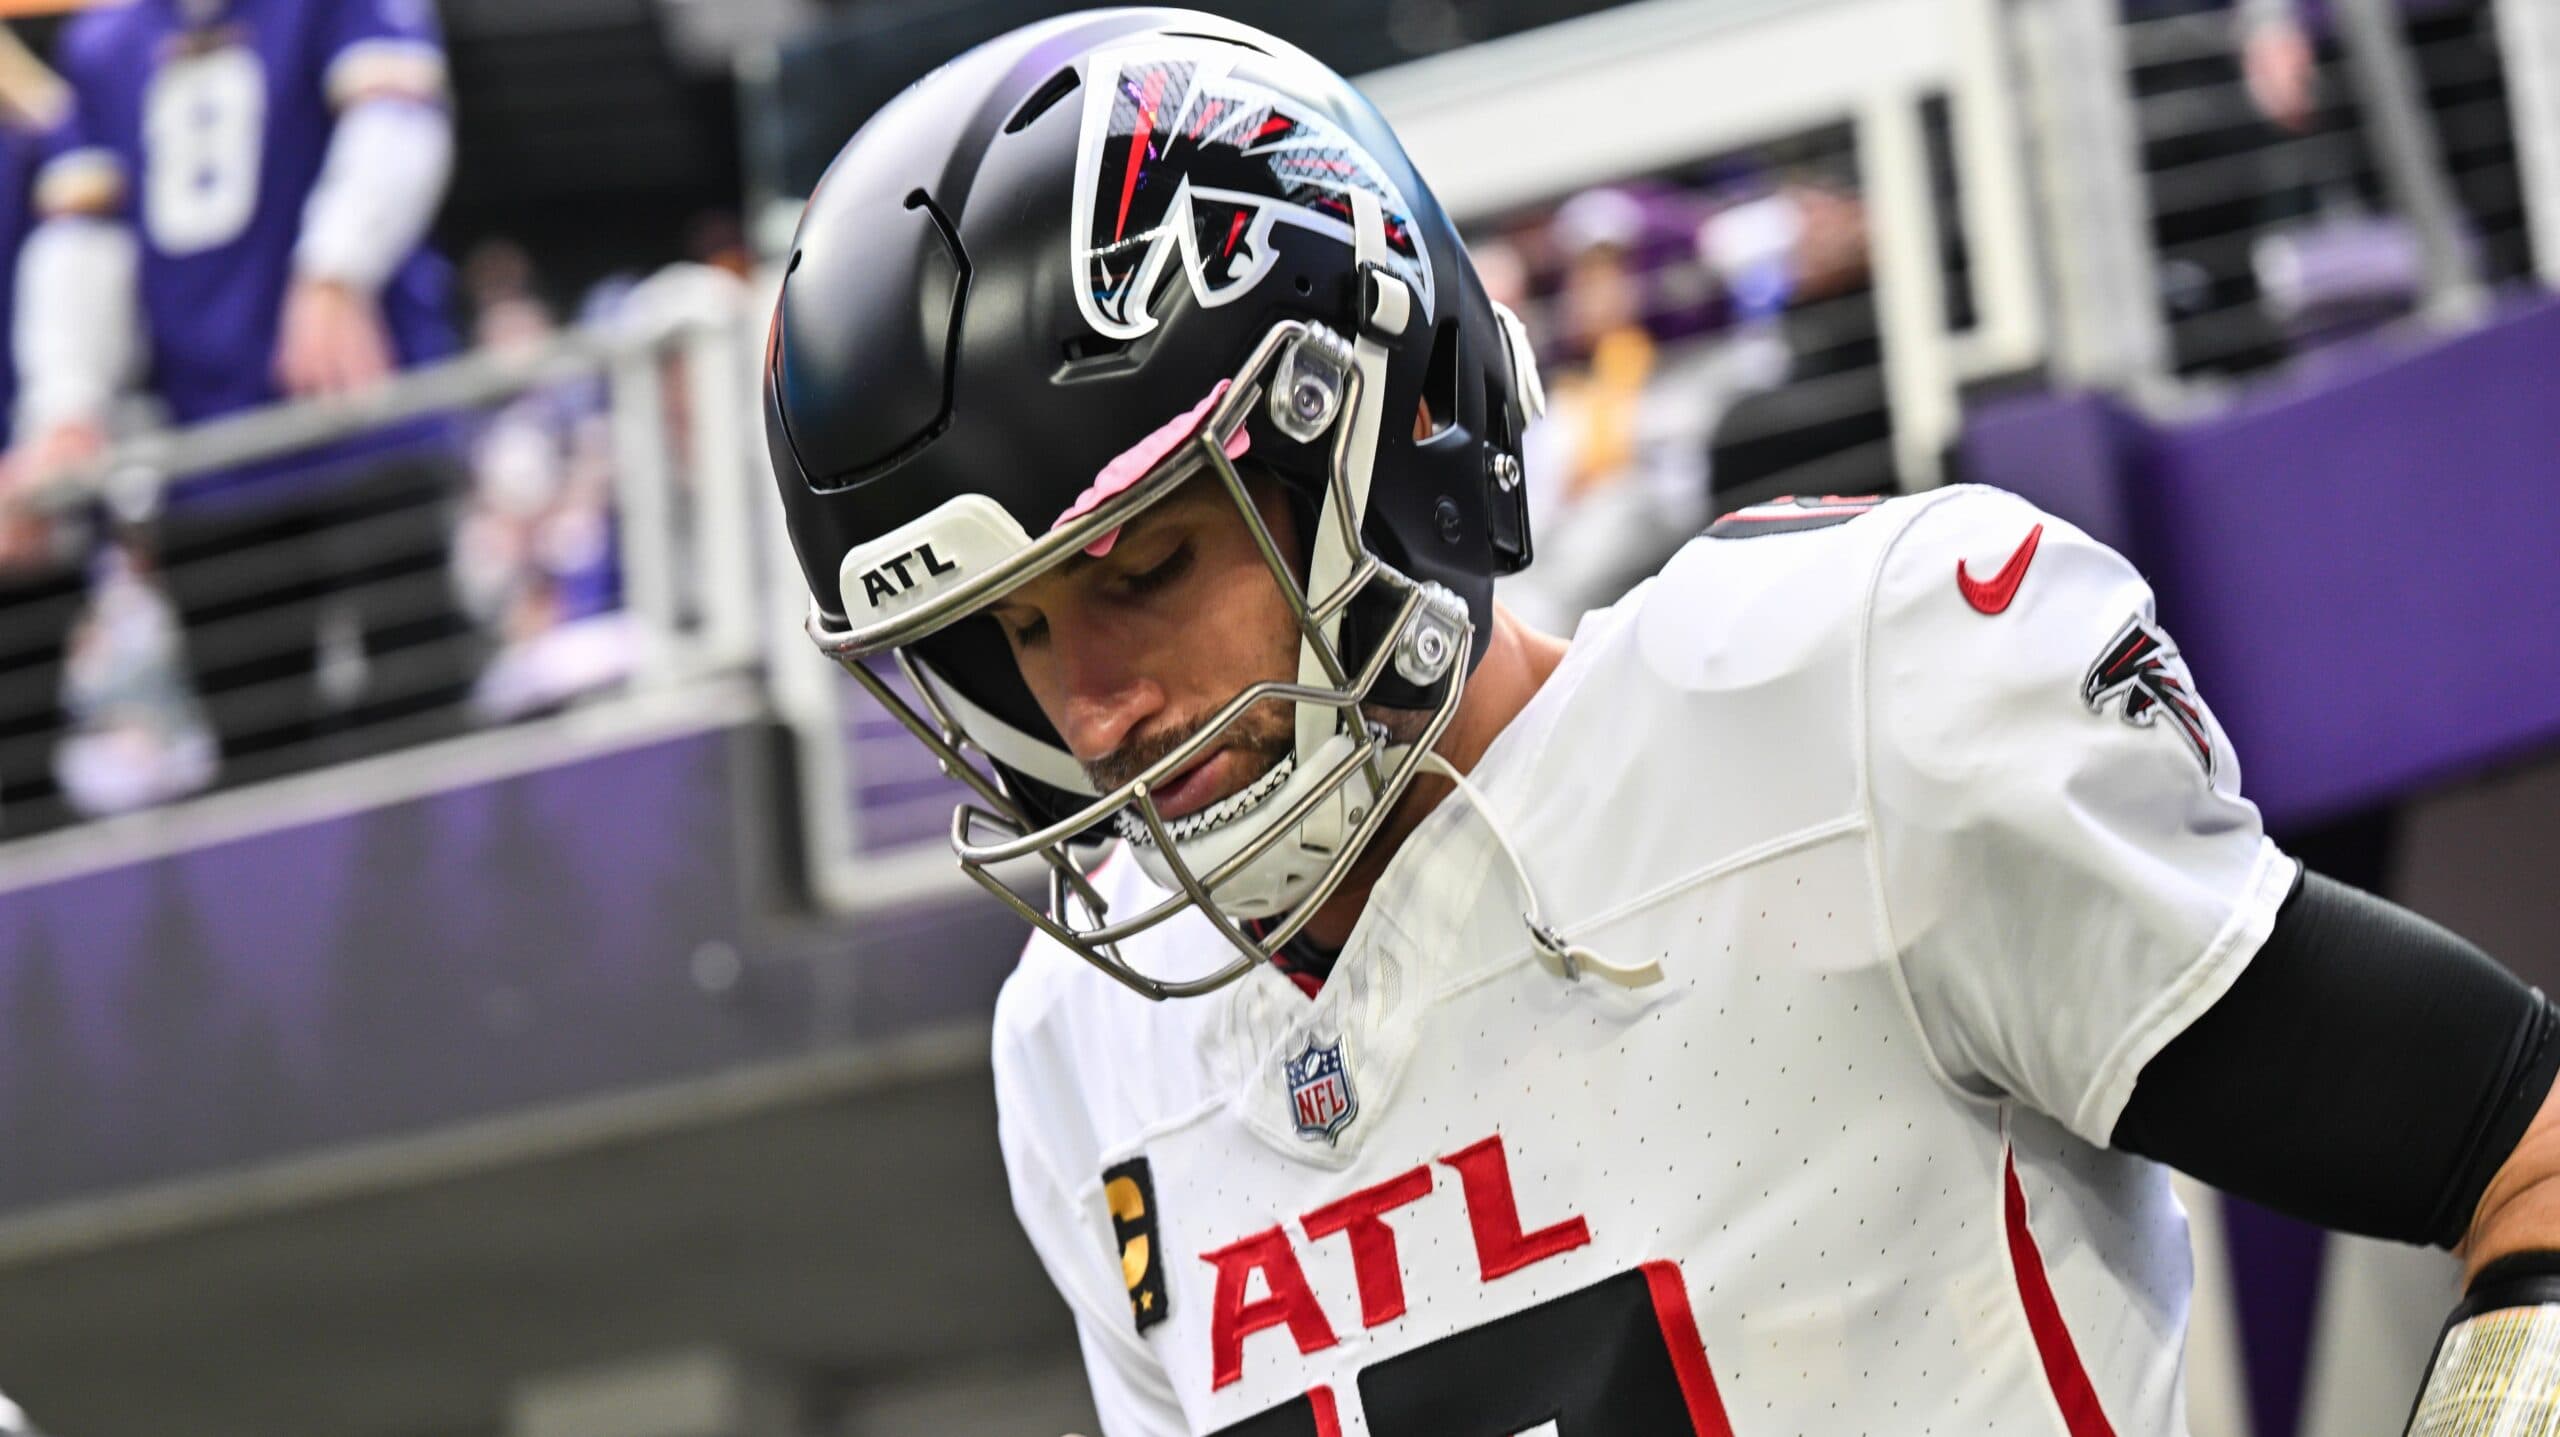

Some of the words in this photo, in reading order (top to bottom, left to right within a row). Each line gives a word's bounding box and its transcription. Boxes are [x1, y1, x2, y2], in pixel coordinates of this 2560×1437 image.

[142, 47, 267, 257] 8
[860, 543, 956, 608] ATL
[1295, 1077, 1345, 1126] NFL
[1199, 1134, 1591, 1392] ATL
